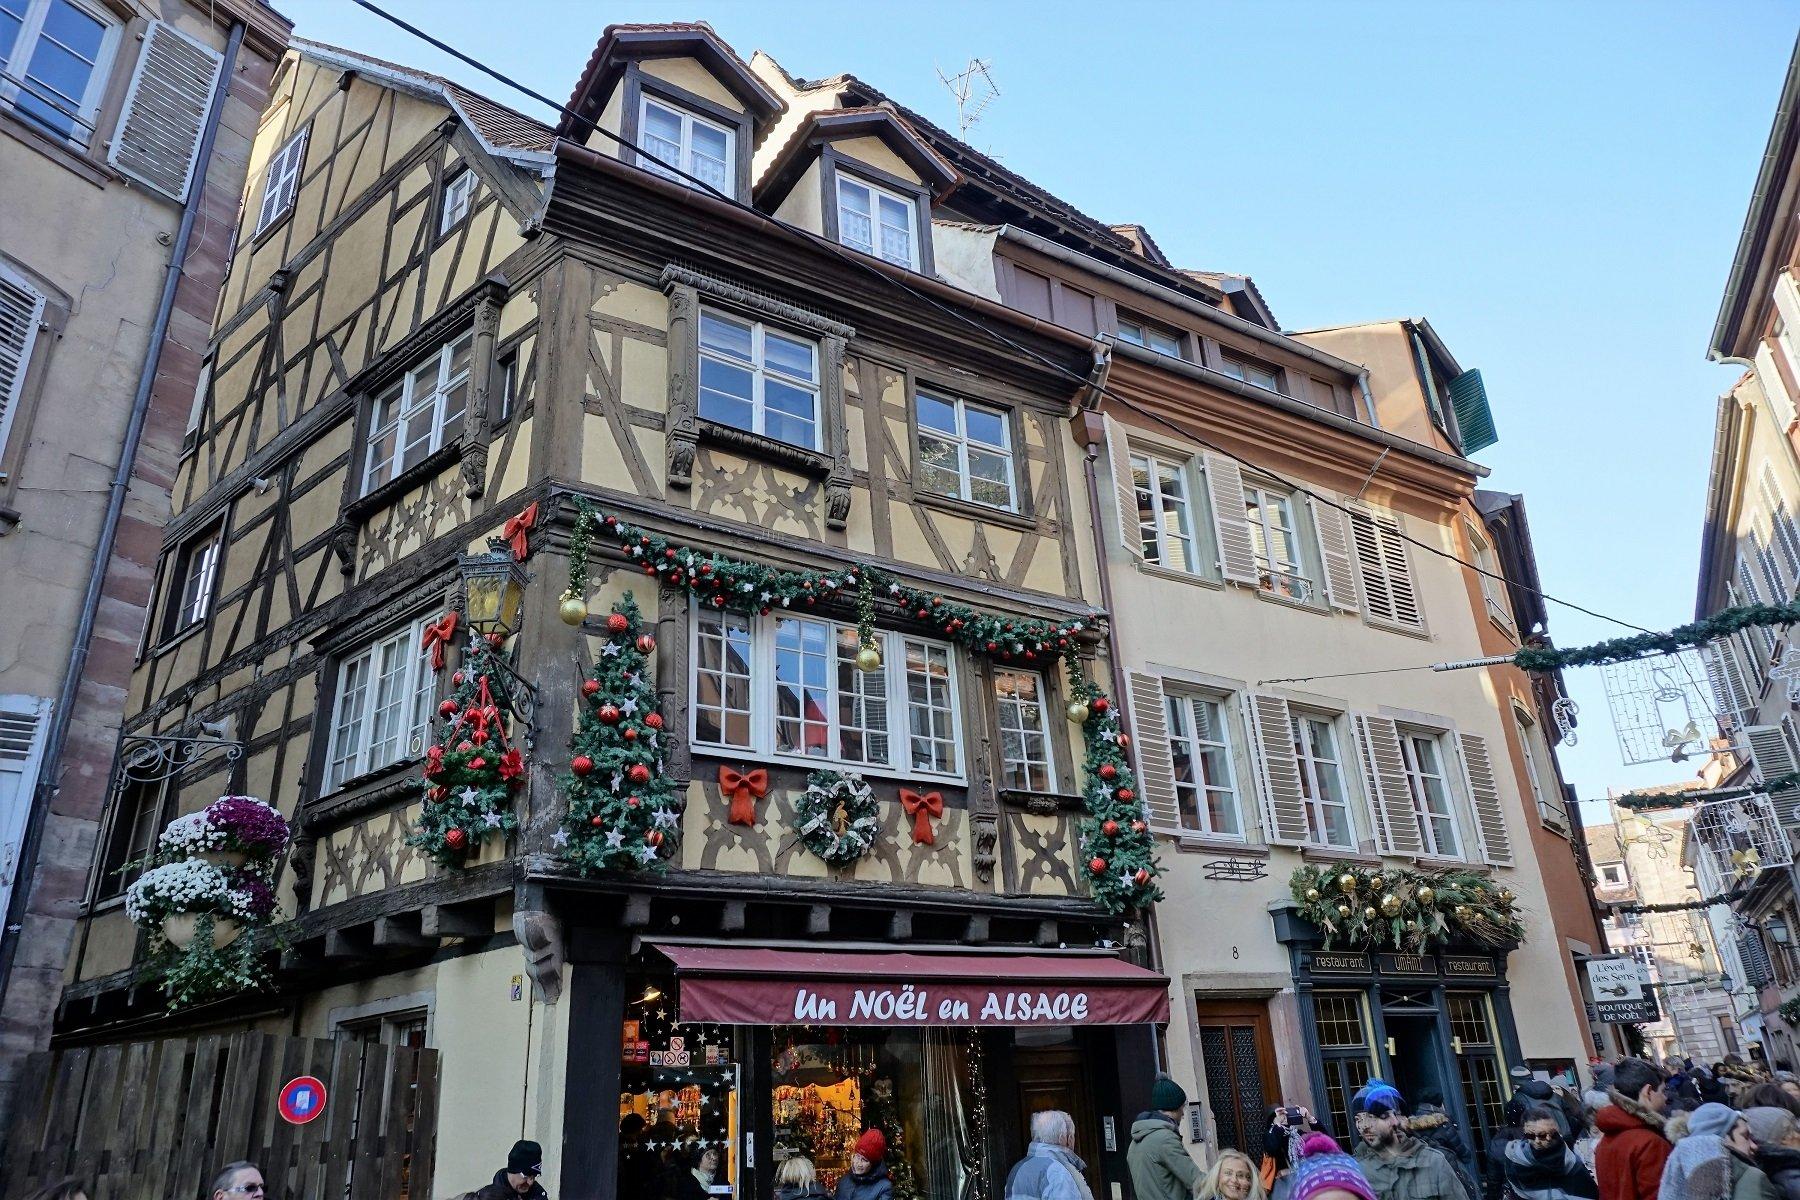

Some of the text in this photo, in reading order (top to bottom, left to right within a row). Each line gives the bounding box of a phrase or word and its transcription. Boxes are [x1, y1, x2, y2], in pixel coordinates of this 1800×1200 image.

[1232, 945, 1239, 960] 8
[1315, 955, 1365, 969] restaurant
[1448, 960, 1491, 972] restaurant
[1592, 973, 1610, 983] des
[1610, 972, 1636, 982] Sens
[793, 984, 1088, 1021] Un NOËL en ALSACE
[1597, 1002, 1644, 1012] BOUTIQUE
[1603, 1013, 1616, 1021] DE
